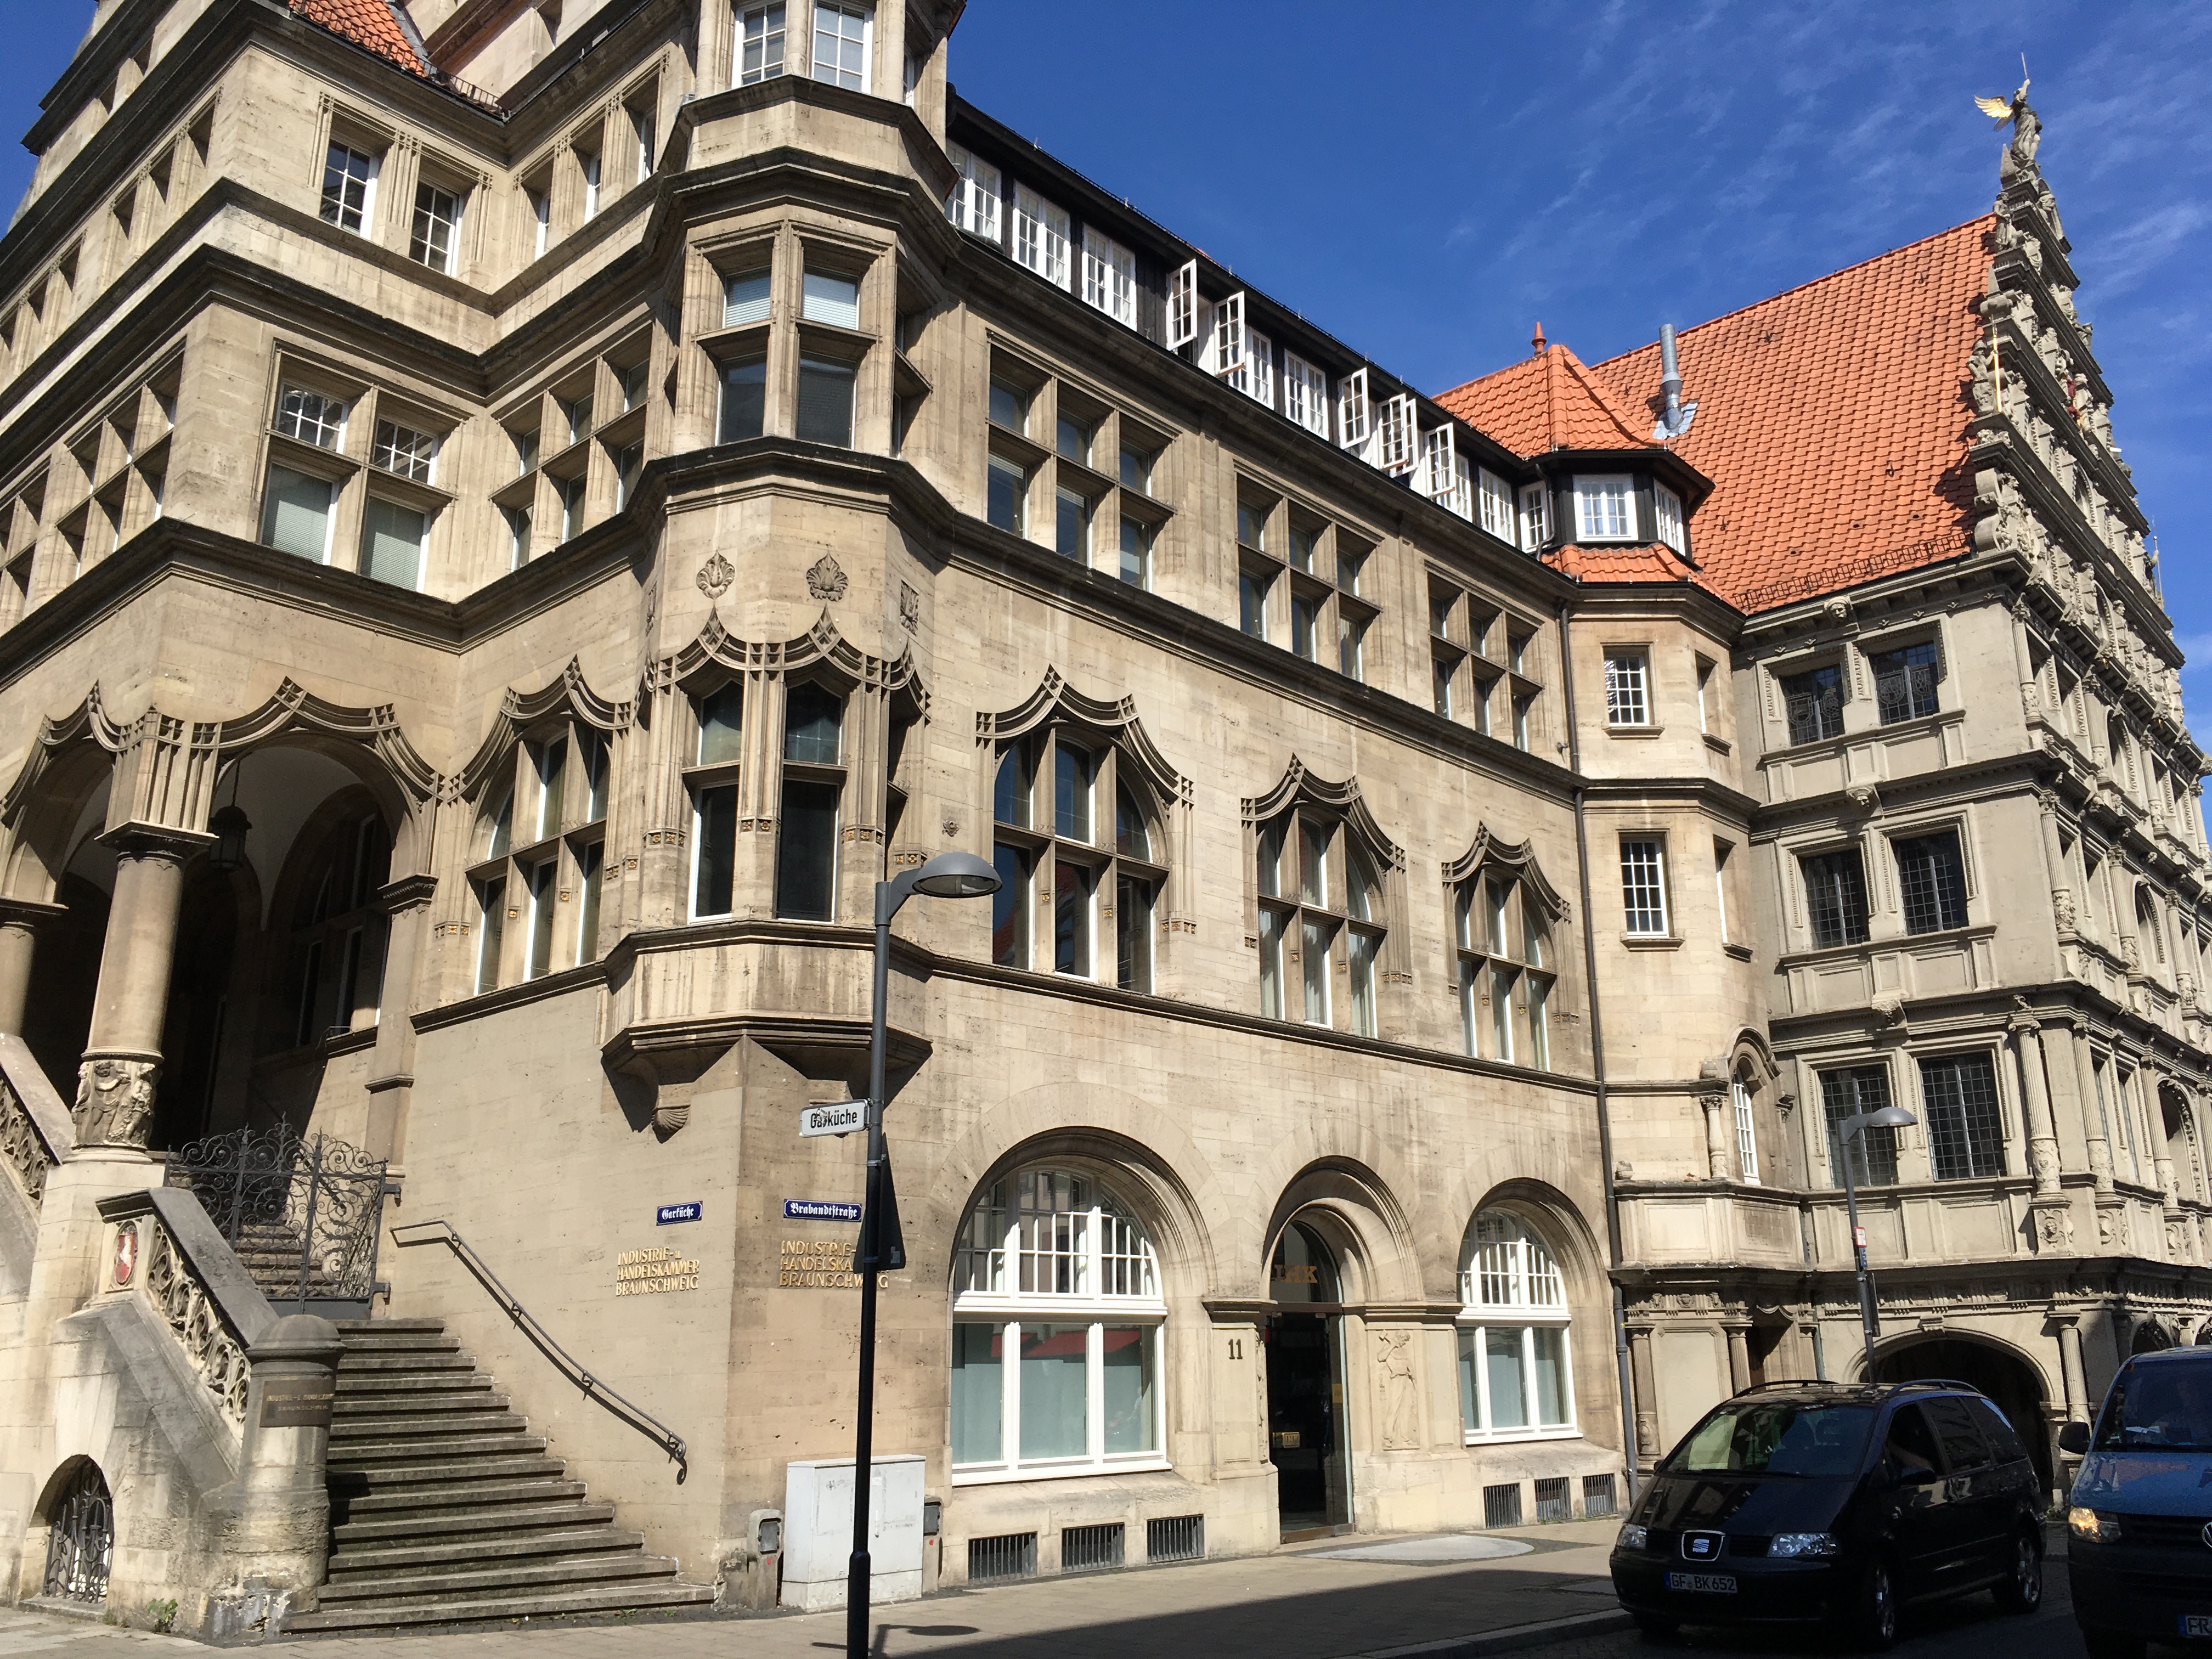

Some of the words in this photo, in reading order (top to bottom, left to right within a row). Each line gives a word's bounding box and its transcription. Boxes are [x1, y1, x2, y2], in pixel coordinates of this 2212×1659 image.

[662, 1206, 694, 1220] Garküche
[617, 1260, 699, 1281] HANDELSKAMMER
[616, 1275, 699, 1296] BRAUNSCHWEIG
[780, 1272, 889, 1288] BRAUNSCHWG
[1228, 1339, 1243, 1359] 11
[1671, 1574, 1686, 1587] GF
